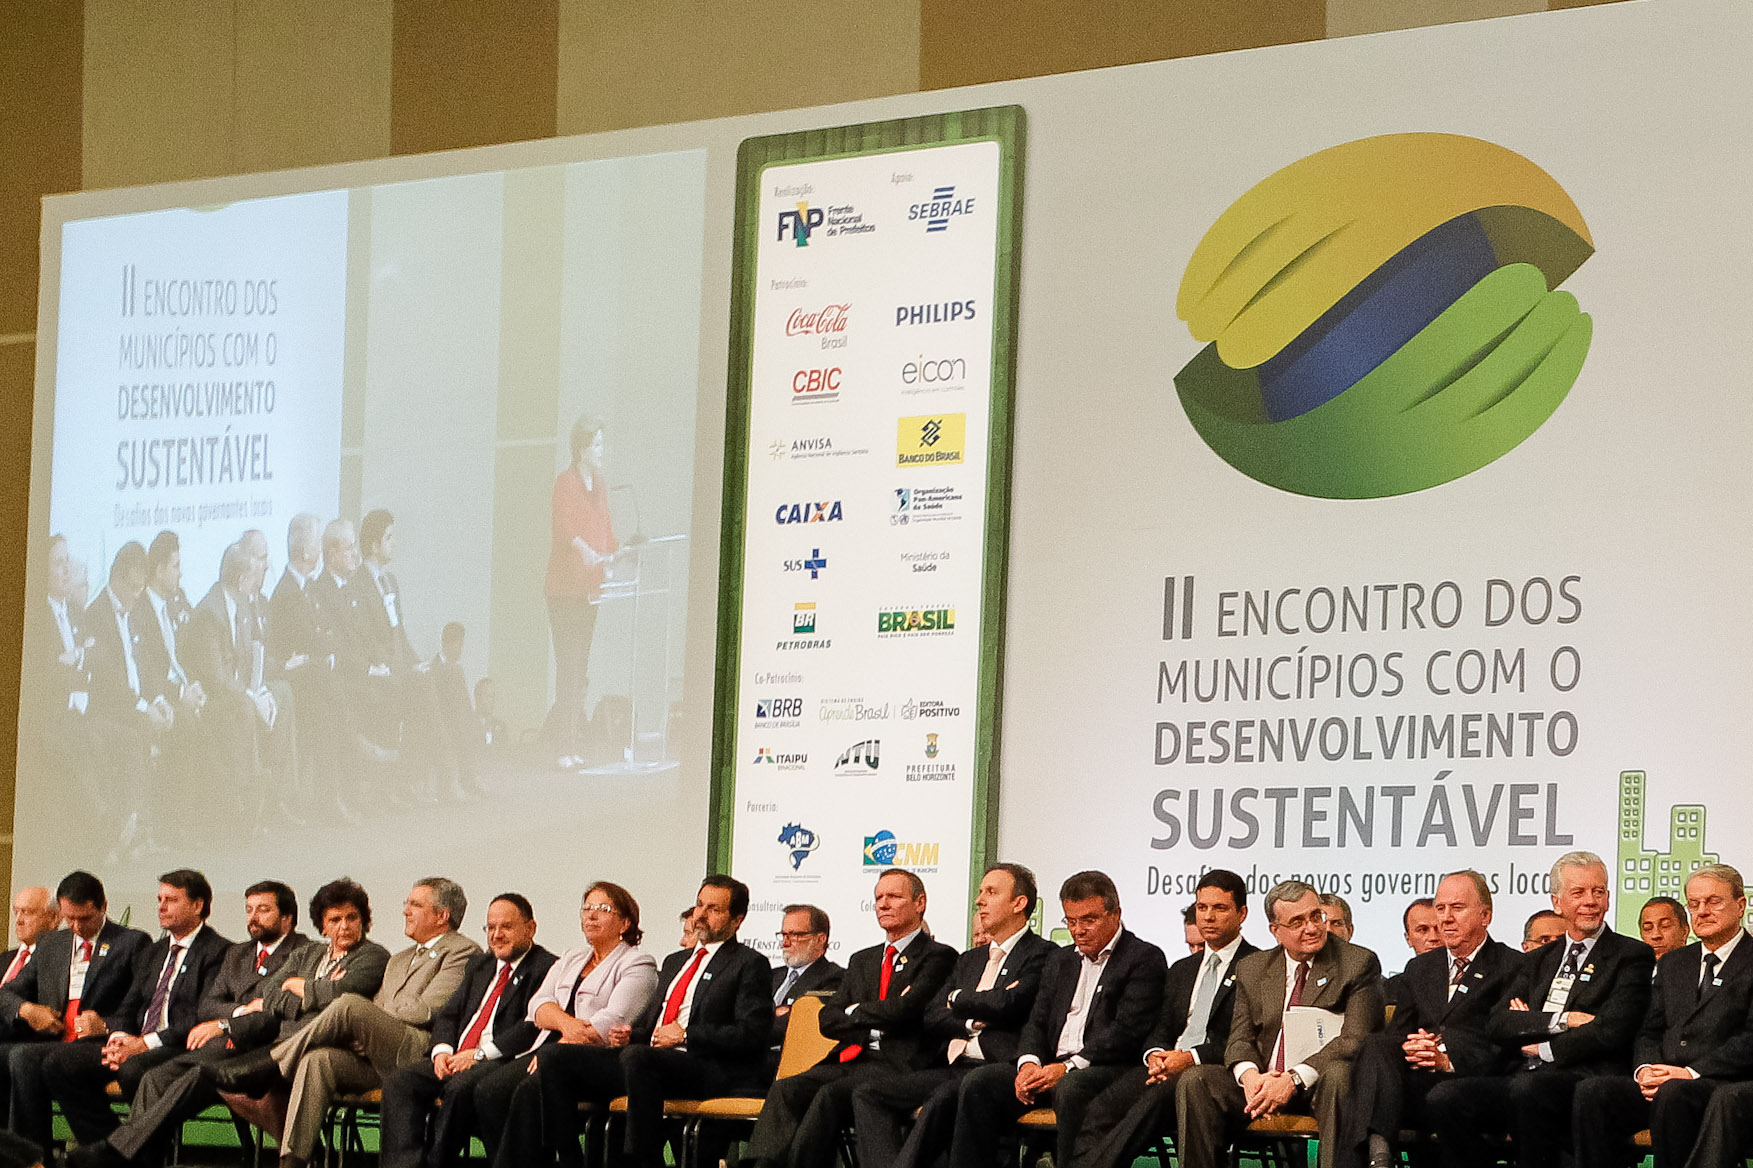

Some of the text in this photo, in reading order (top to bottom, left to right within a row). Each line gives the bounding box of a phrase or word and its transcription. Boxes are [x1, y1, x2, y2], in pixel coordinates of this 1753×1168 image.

[908, 198, 975, 220] SEBRAE
[777, 207, 824, 242] FNP
[121, 263, 278, 317] II ENCONTRO DOS
[895, 300, 976, 326] PHILIPS
[118, 326, 278, 369] MUNICÍPIOS COM O
[821, 335, 847, 350] Brasil
[792, 367, 842, 393] CBIC
[902, 354, 966, 384] eicon
[118, 380, 276, 421] DESENVOLVIMENTO
[791, 438, 832, 451] ANVISA
[116, 424, 273, 490] SUSTENTÁVEL
[776, 500, 843, 524] CAIXA
[783, 560, 802, 572] SUS
[1161, 575, 1583, 641] II ENCONTRO DOS
[795, 614, 815, 627] BR
[878, 609, 955, 632] BRASIL
[776, 639, 832, 650] PETROBRAS
[1156, 645, 1582, 705] MUNICÍPIOS COM O
[772, 698, 803, 718] BRB
[919, 707, 960, 718] POSITIVO
[1153, 710, 1579, 766] DESENVOLVIMENTO
[776, 754, 808, 764] ITAIPU
[906, 764, 956, 773] PREFEITURA
[1149, 770, 1574, 850] SUSTENTÁVEL
[892, 843, 939, 866] CNM
